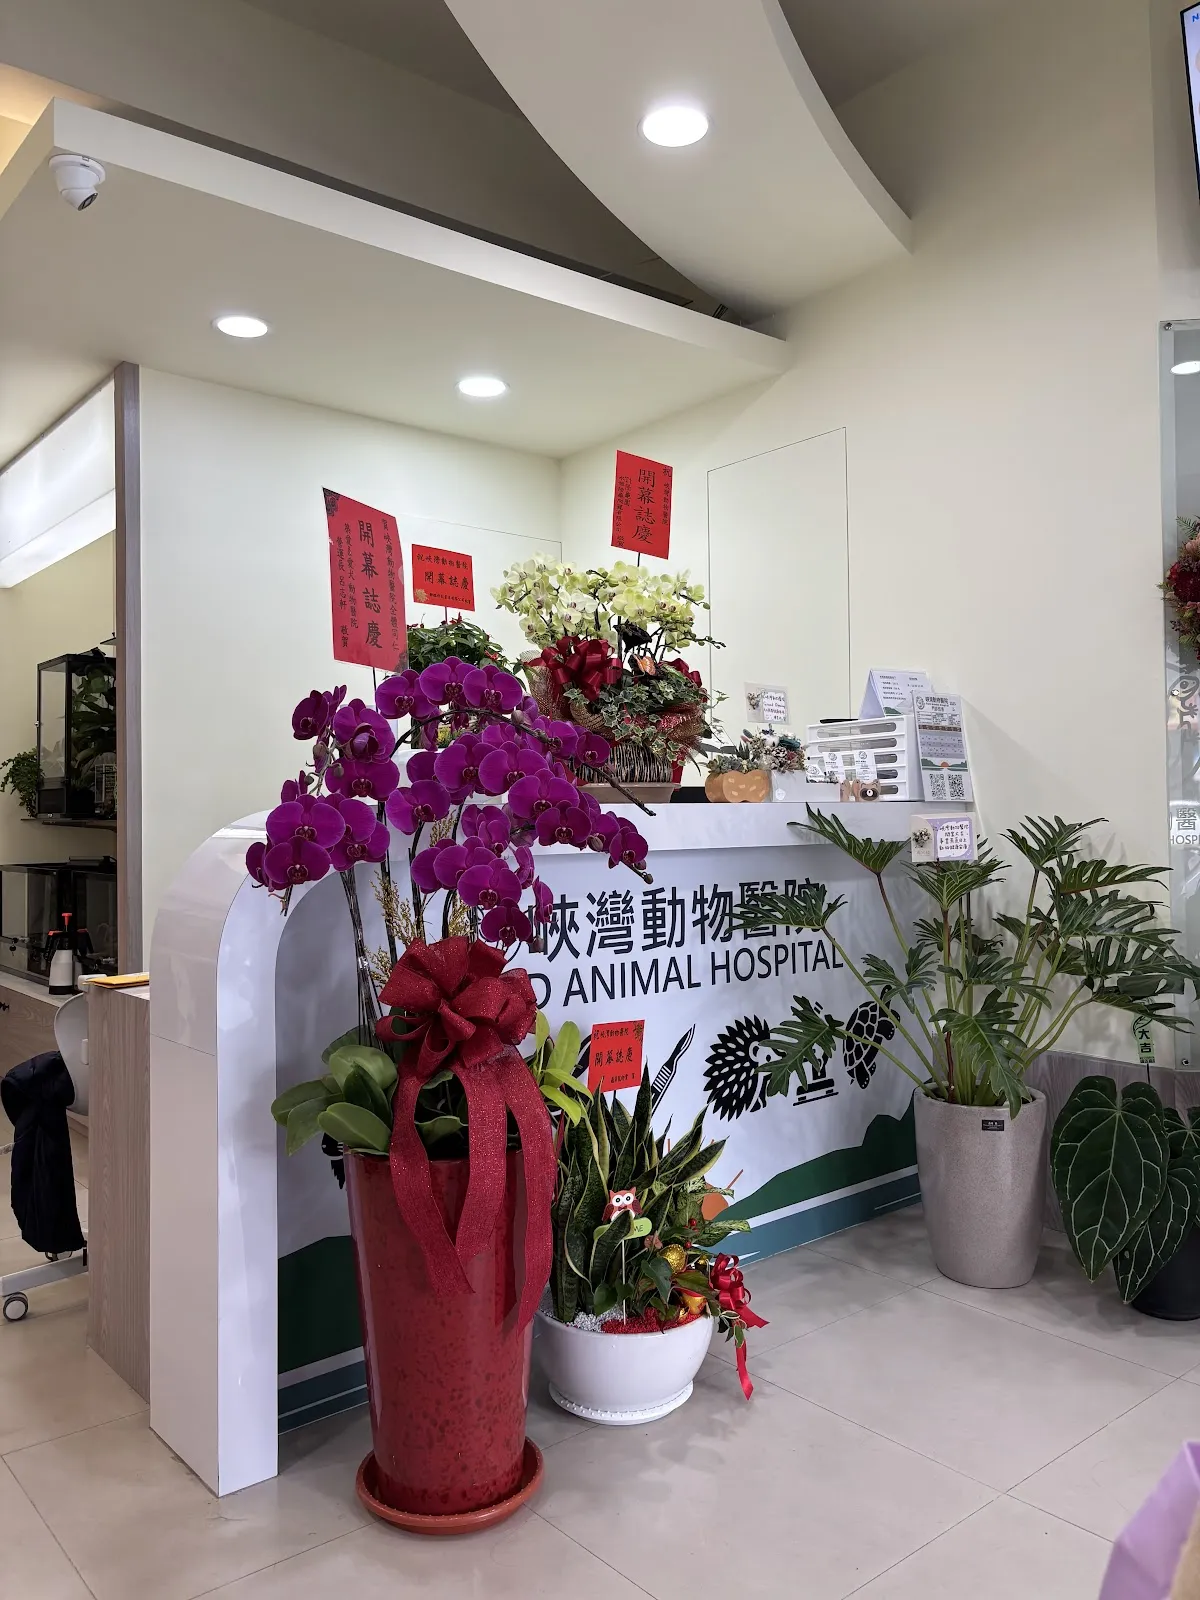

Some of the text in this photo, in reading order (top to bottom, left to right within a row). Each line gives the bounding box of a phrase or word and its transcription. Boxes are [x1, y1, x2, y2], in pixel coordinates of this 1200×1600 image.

[632, 468, 656, 545] 開幕誌慶
[358, 520, 382, 649] 開幕誌慶
[424, 571, 470, 592] 開幕誌慶
[562, 954, 702, 1008] ANIMAL
[710, 938, 844, 986] HOSPITAL
[1138, 1029, 1152, 1053] 大吉
